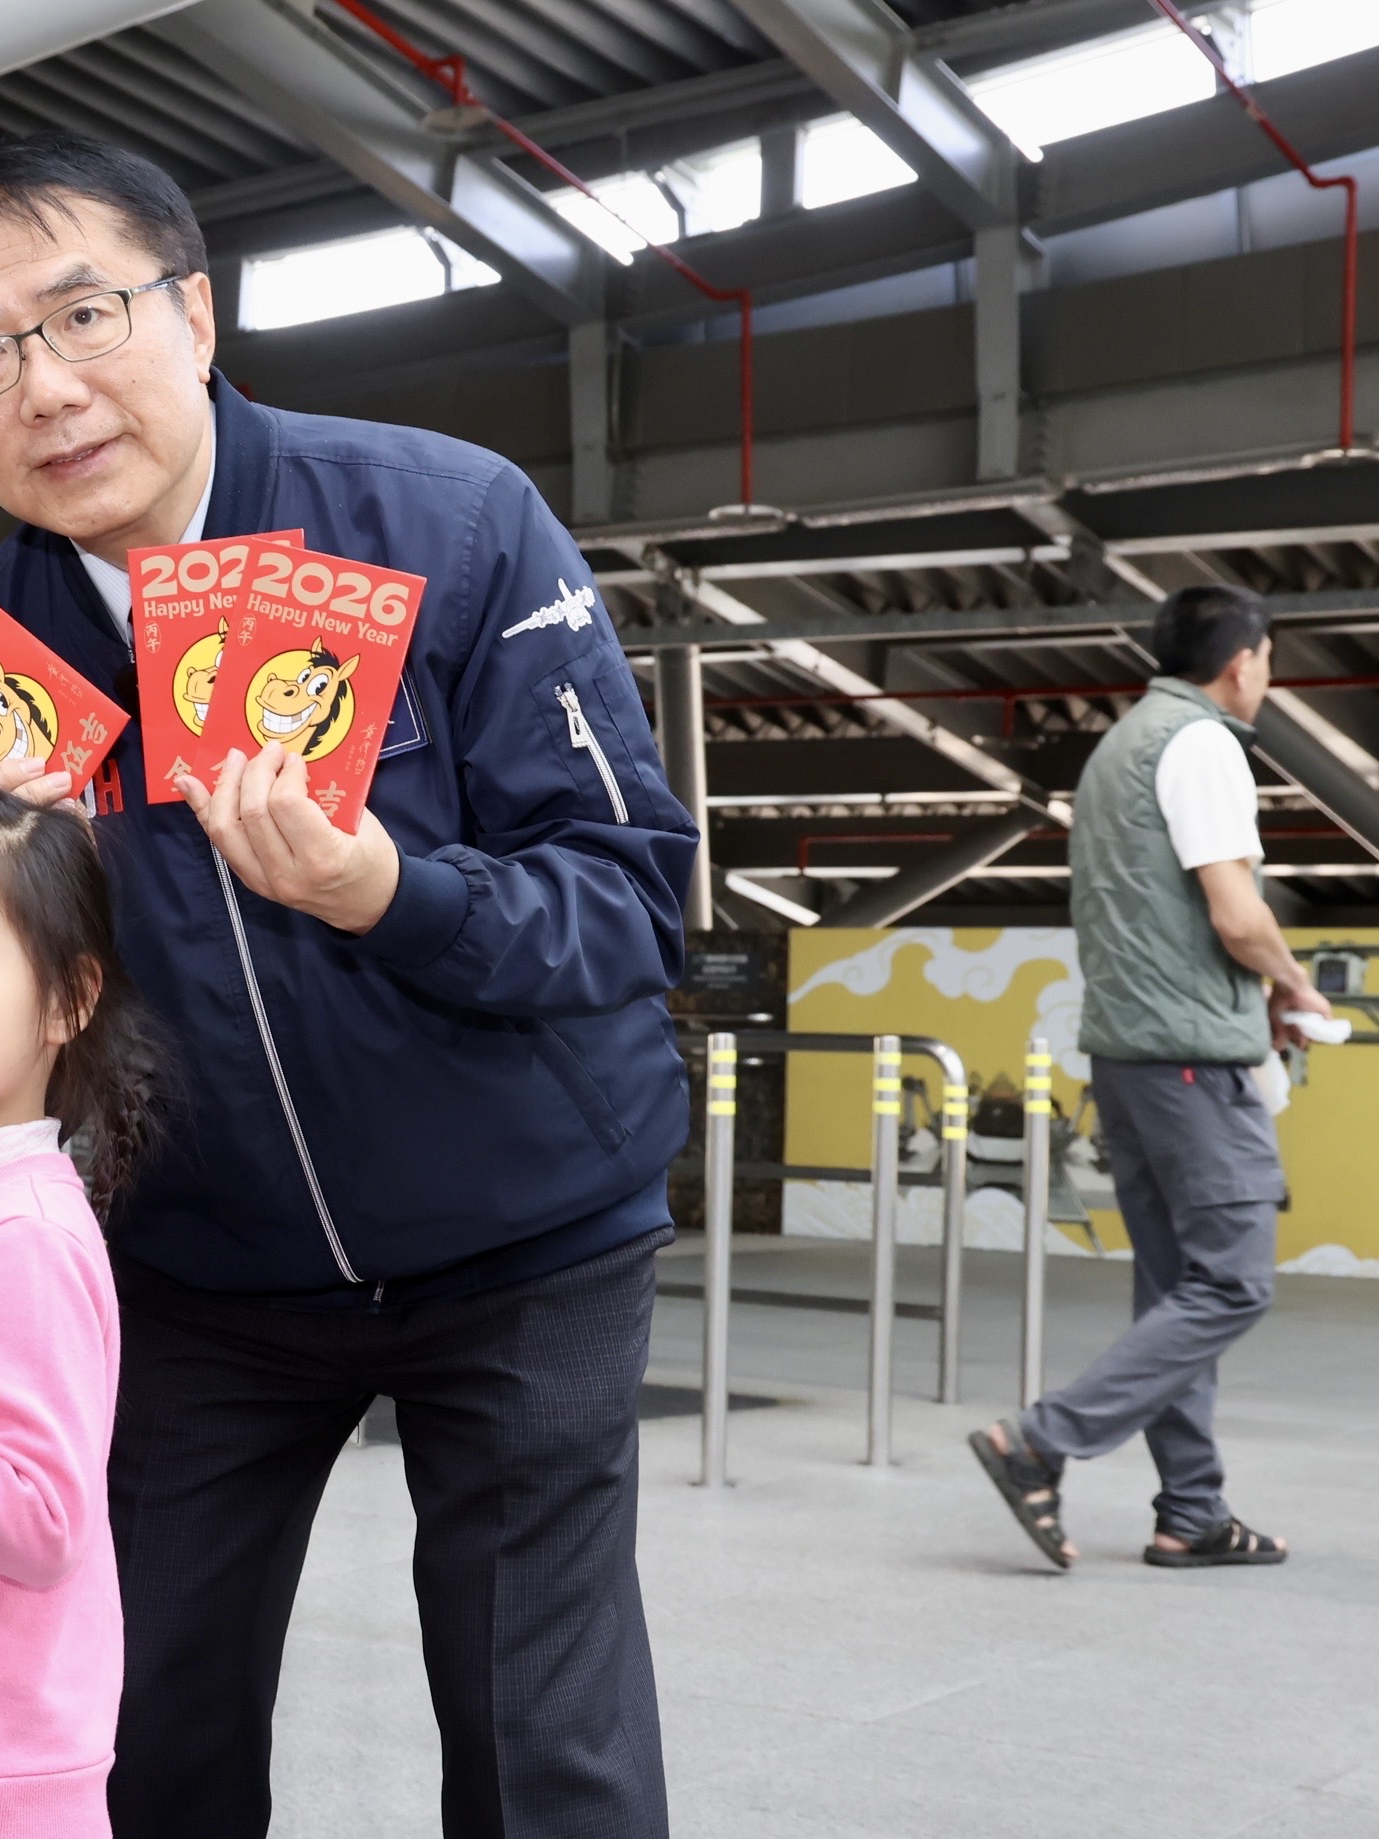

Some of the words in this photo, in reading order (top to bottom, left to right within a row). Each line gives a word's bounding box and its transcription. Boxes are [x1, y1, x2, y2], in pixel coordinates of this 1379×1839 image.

[140, 544, 251, 600] 202
[251, 551, 410, 627] 2026
[143, 598, 204, 620] Happy
[246, 593, 309, 628] Happy
[311, 612, 353, 635] New
[357, 622, 399, 648] Year
[145, 623, 162, 654] 丙午
[238, 616, 257, 646] 丙午
